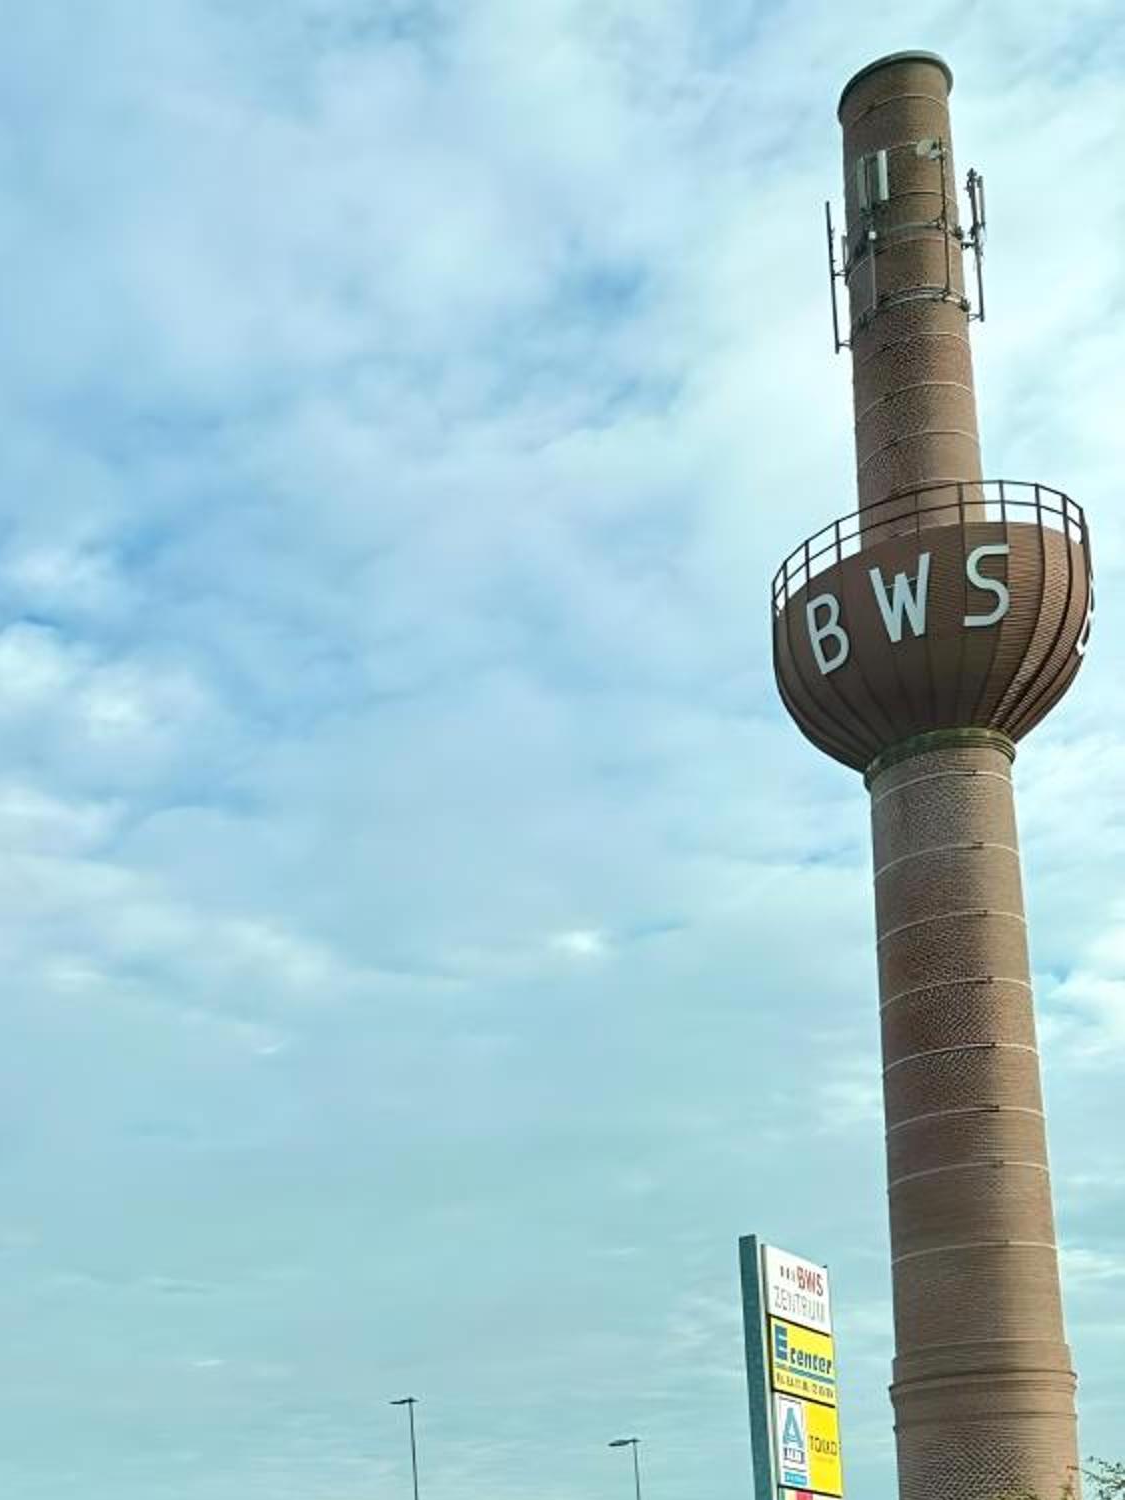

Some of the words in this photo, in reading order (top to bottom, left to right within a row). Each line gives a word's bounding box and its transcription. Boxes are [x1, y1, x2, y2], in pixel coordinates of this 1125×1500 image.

[806, 543, 1010, 675] BWS
[796, 1265, 824, 1296] BWS
[775, 1324, 787, 1360] E
[790, 1346, 832, 1374] center
